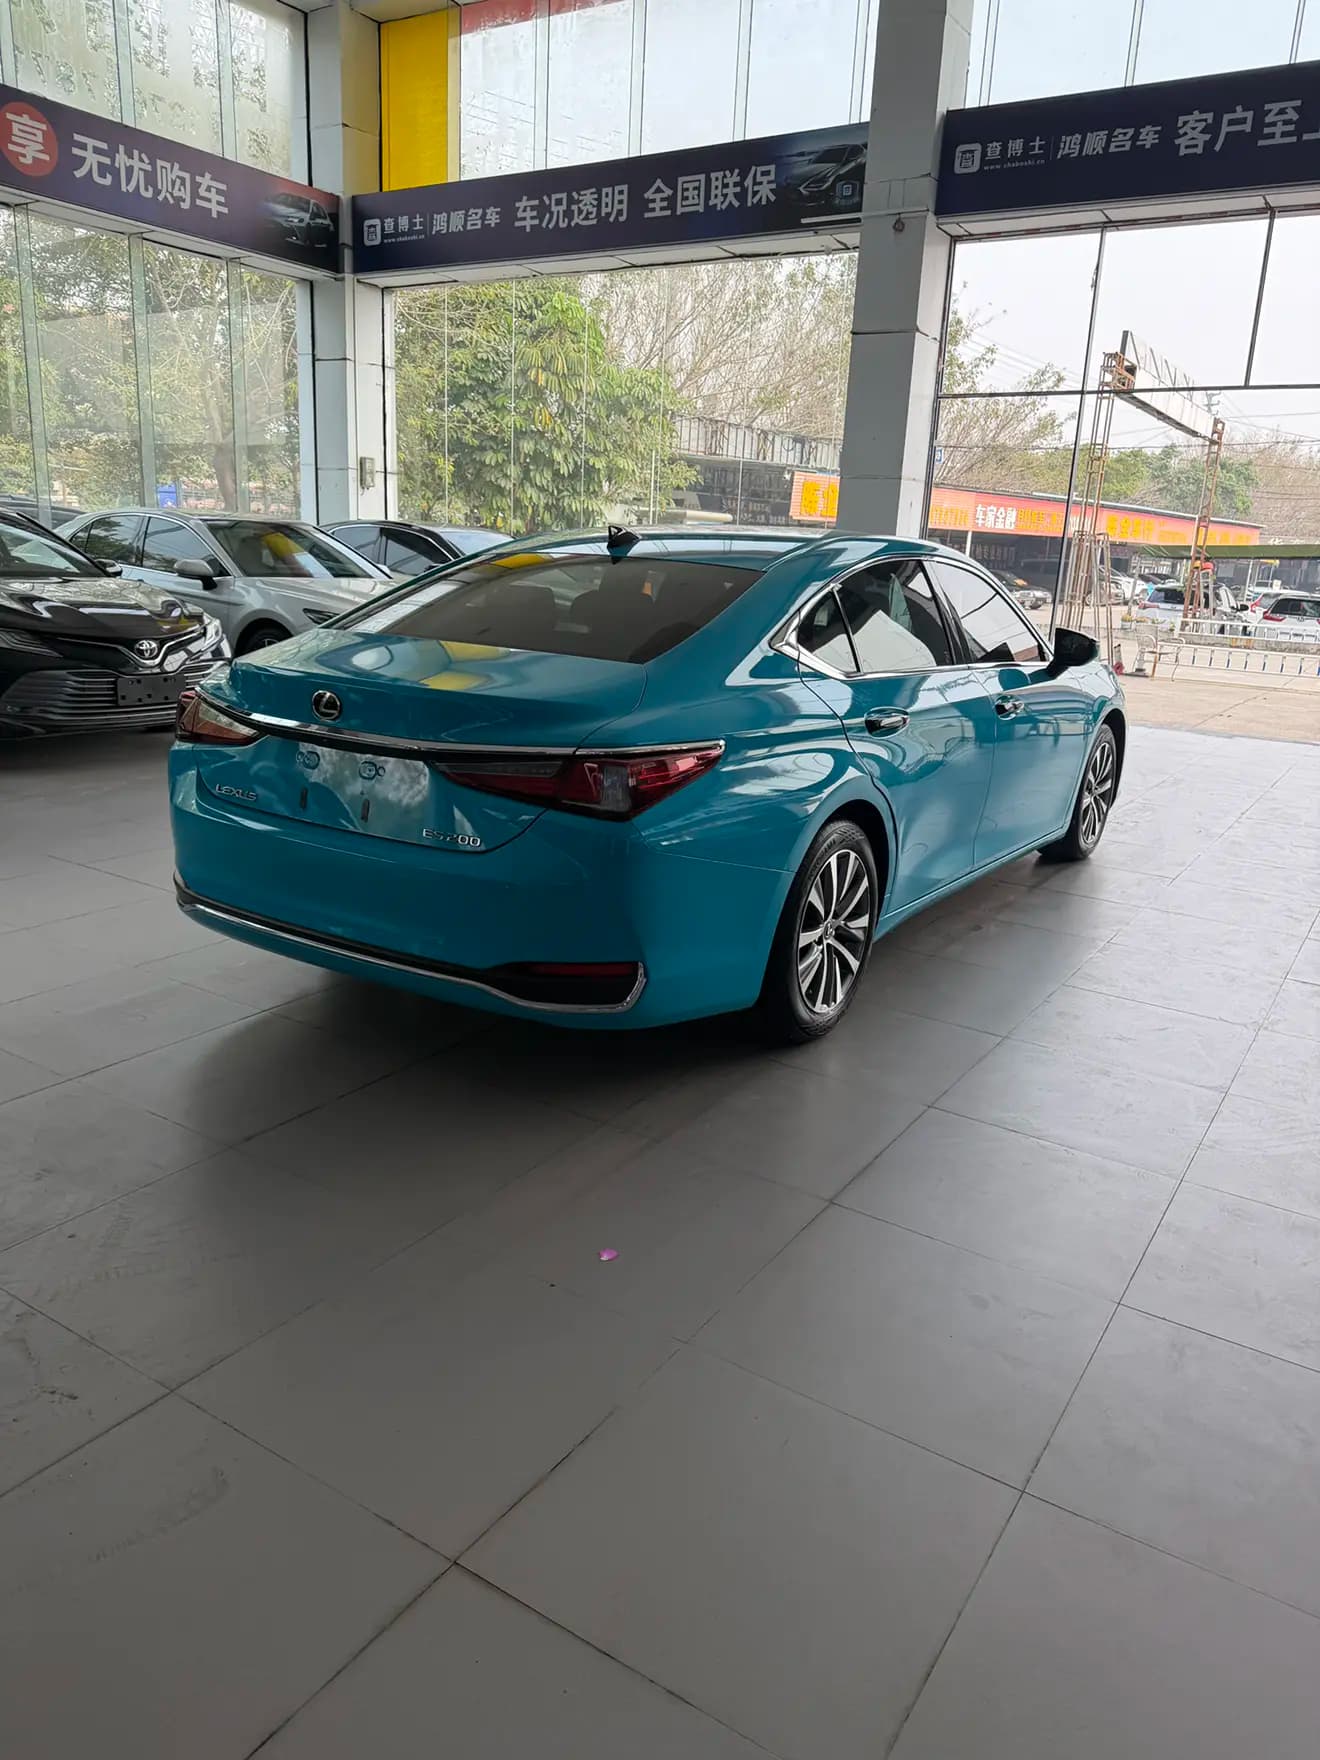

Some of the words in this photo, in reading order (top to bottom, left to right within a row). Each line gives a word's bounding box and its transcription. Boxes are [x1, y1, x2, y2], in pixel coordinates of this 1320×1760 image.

[6, 113, 50, 165] 享
[71, 132, 229, 219] 无忧购车
[983, 136, 1046, 160] 查博士
[1056, 125, 1162, 160] 鸿顺名车
[383, 213, 424, 234] 查博士
[431, 206, 501, 235] 鸿顺名车
[514, 183, 629, 233] 车况透明
[643, 163, 777, 220] 全国联保
[215, 783, 257, 801] LEXUS
